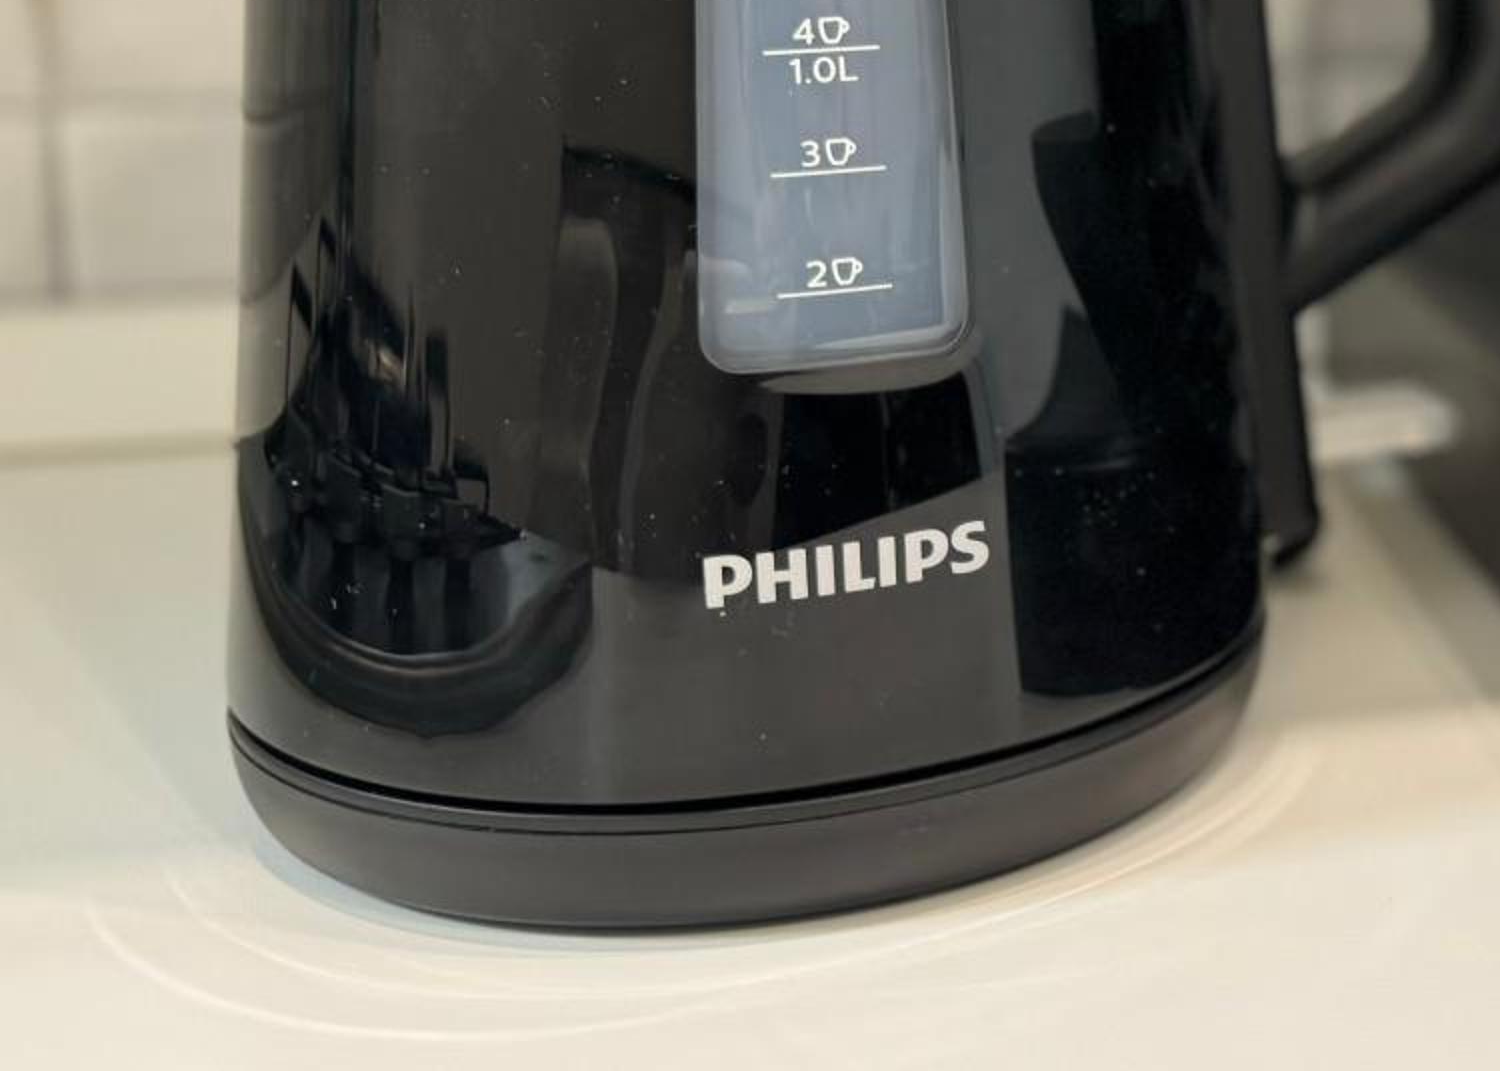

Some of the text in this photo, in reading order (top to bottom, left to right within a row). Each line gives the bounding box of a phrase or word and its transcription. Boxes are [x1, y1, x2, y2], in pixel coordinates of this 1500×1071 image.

[792, 18, 815, 46] 4
[788, 55, 859, 85] 1.0L
[801, 139, 821, 168] 3
[806, 260, 828, 289] 2
[703, 520, 990, 610] PHILIPS
